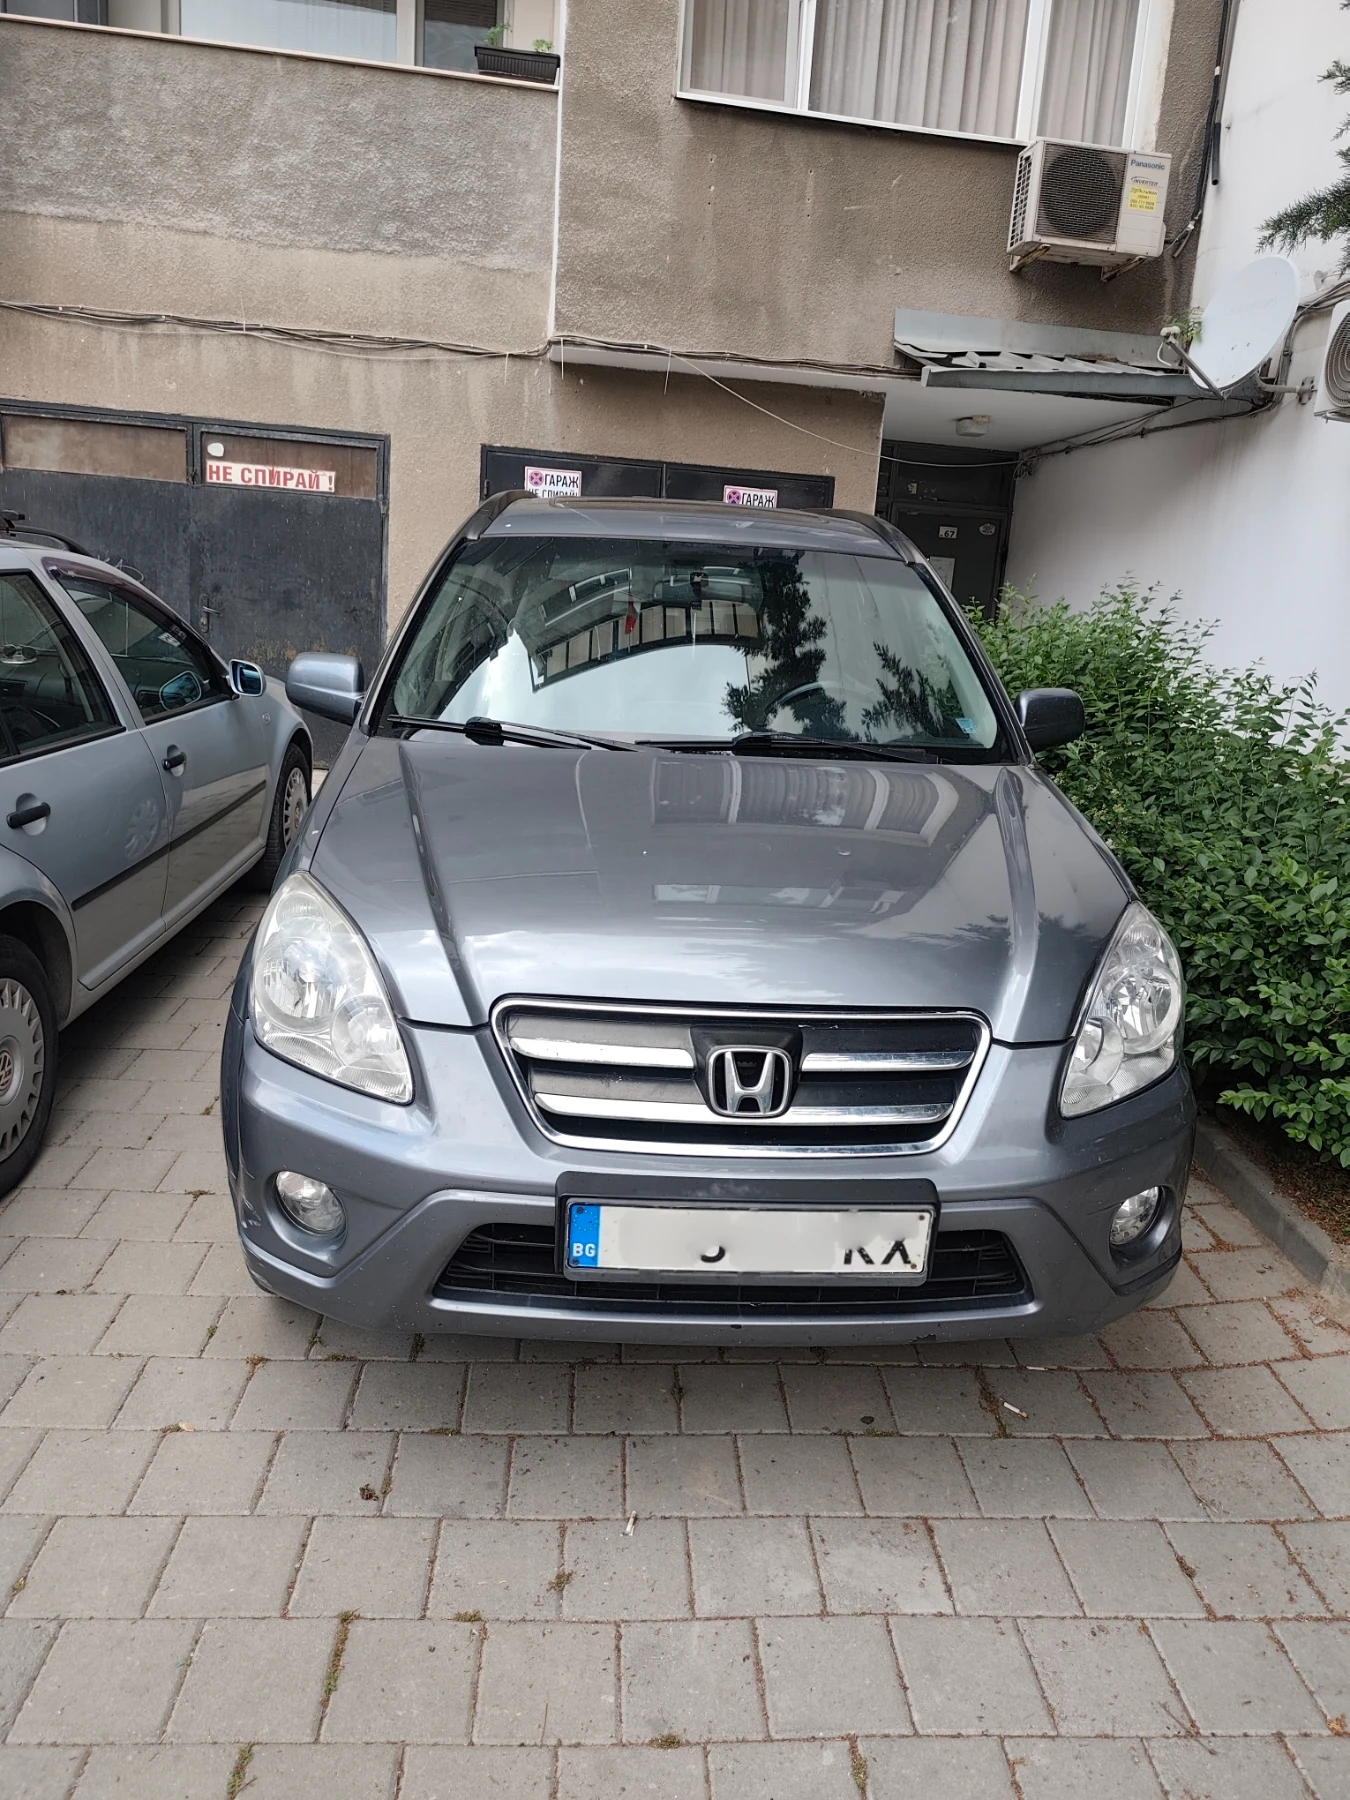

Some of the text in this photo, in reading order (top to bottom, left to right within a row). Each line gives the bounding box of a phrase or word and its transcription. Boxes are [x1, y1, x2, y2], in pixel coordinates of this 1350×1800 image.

[1130, 159, 1165, 171] Panasonic
[1132, 179, 1159, 187] INVERTER
[208, 464, 233, 482] НЕ
[240, 467, 320, 490] СПИРАЙ
[544, 474, 579, 488] ГАРАЖ
[741, 492, 775, 508] ГАРАЖ
[944, 530, 955, 538] 67
[572, 1242, 596, 1257] BG
